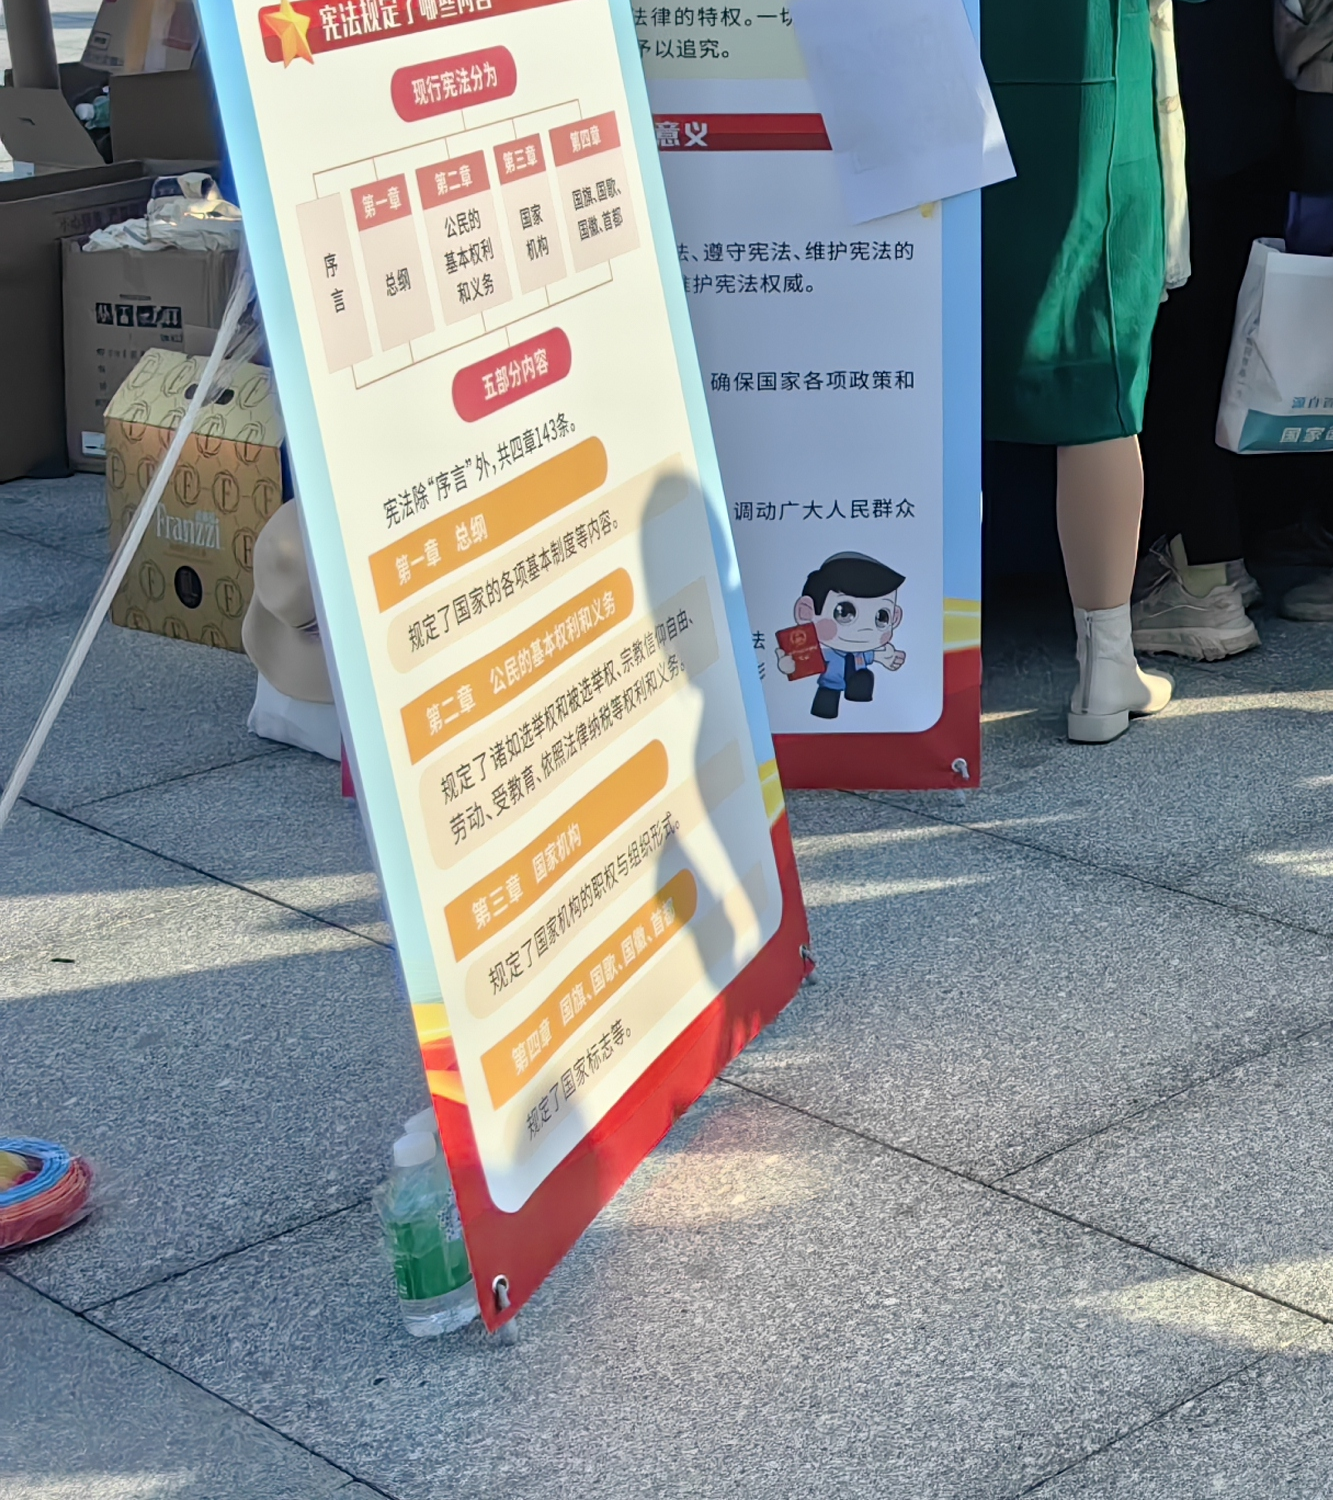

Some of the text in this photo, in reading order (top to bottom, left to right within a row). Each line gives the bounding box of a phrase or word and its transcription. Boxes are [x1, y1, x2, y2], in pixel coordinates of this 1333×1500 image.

[411, 62, 498, 106] 现行宪法分为
[569, 125, 602, 153] 第四章
[502, 145, 538, 175] 第三章
[434, 165, 473, 196] 第二章
[361, 186, 402, 219] 第一章
[520, 204, 544, 230] 国家
[444, 208, 480, 239] 公民的
[578, 206, 624, 242] 国徽、首都
[444, 238, 495, 275] 基本权利
[526, 234, 550, 262] 机构
[385, 268, 412, 297] 总纲
[456, 273, 495, 305] 和义务
[481, 348, 550, 401] 五部分内容
[710, 369, 915, 392] 确保国家各项政策和
[155, 502, 222, 550] Franzzi
[734, 498, 916, 522] 调动广大人民群众
[395, 513, 489, 586] 第一章 总纲
[407, 509, 619, 653] 规定了国家的各项基本制度等内容。
[426, 590, 616, 736] 第二章 公民的基本权利和义务
[471, 822, 582, 930] 第三章 国家机构
[489, 811, 680, 996] 规定了国家机构的职权与组织形式。
[510, 1017, 553, 1077] 第四章
[526, 1018, 632, 1141] 规定了国家标志等。
